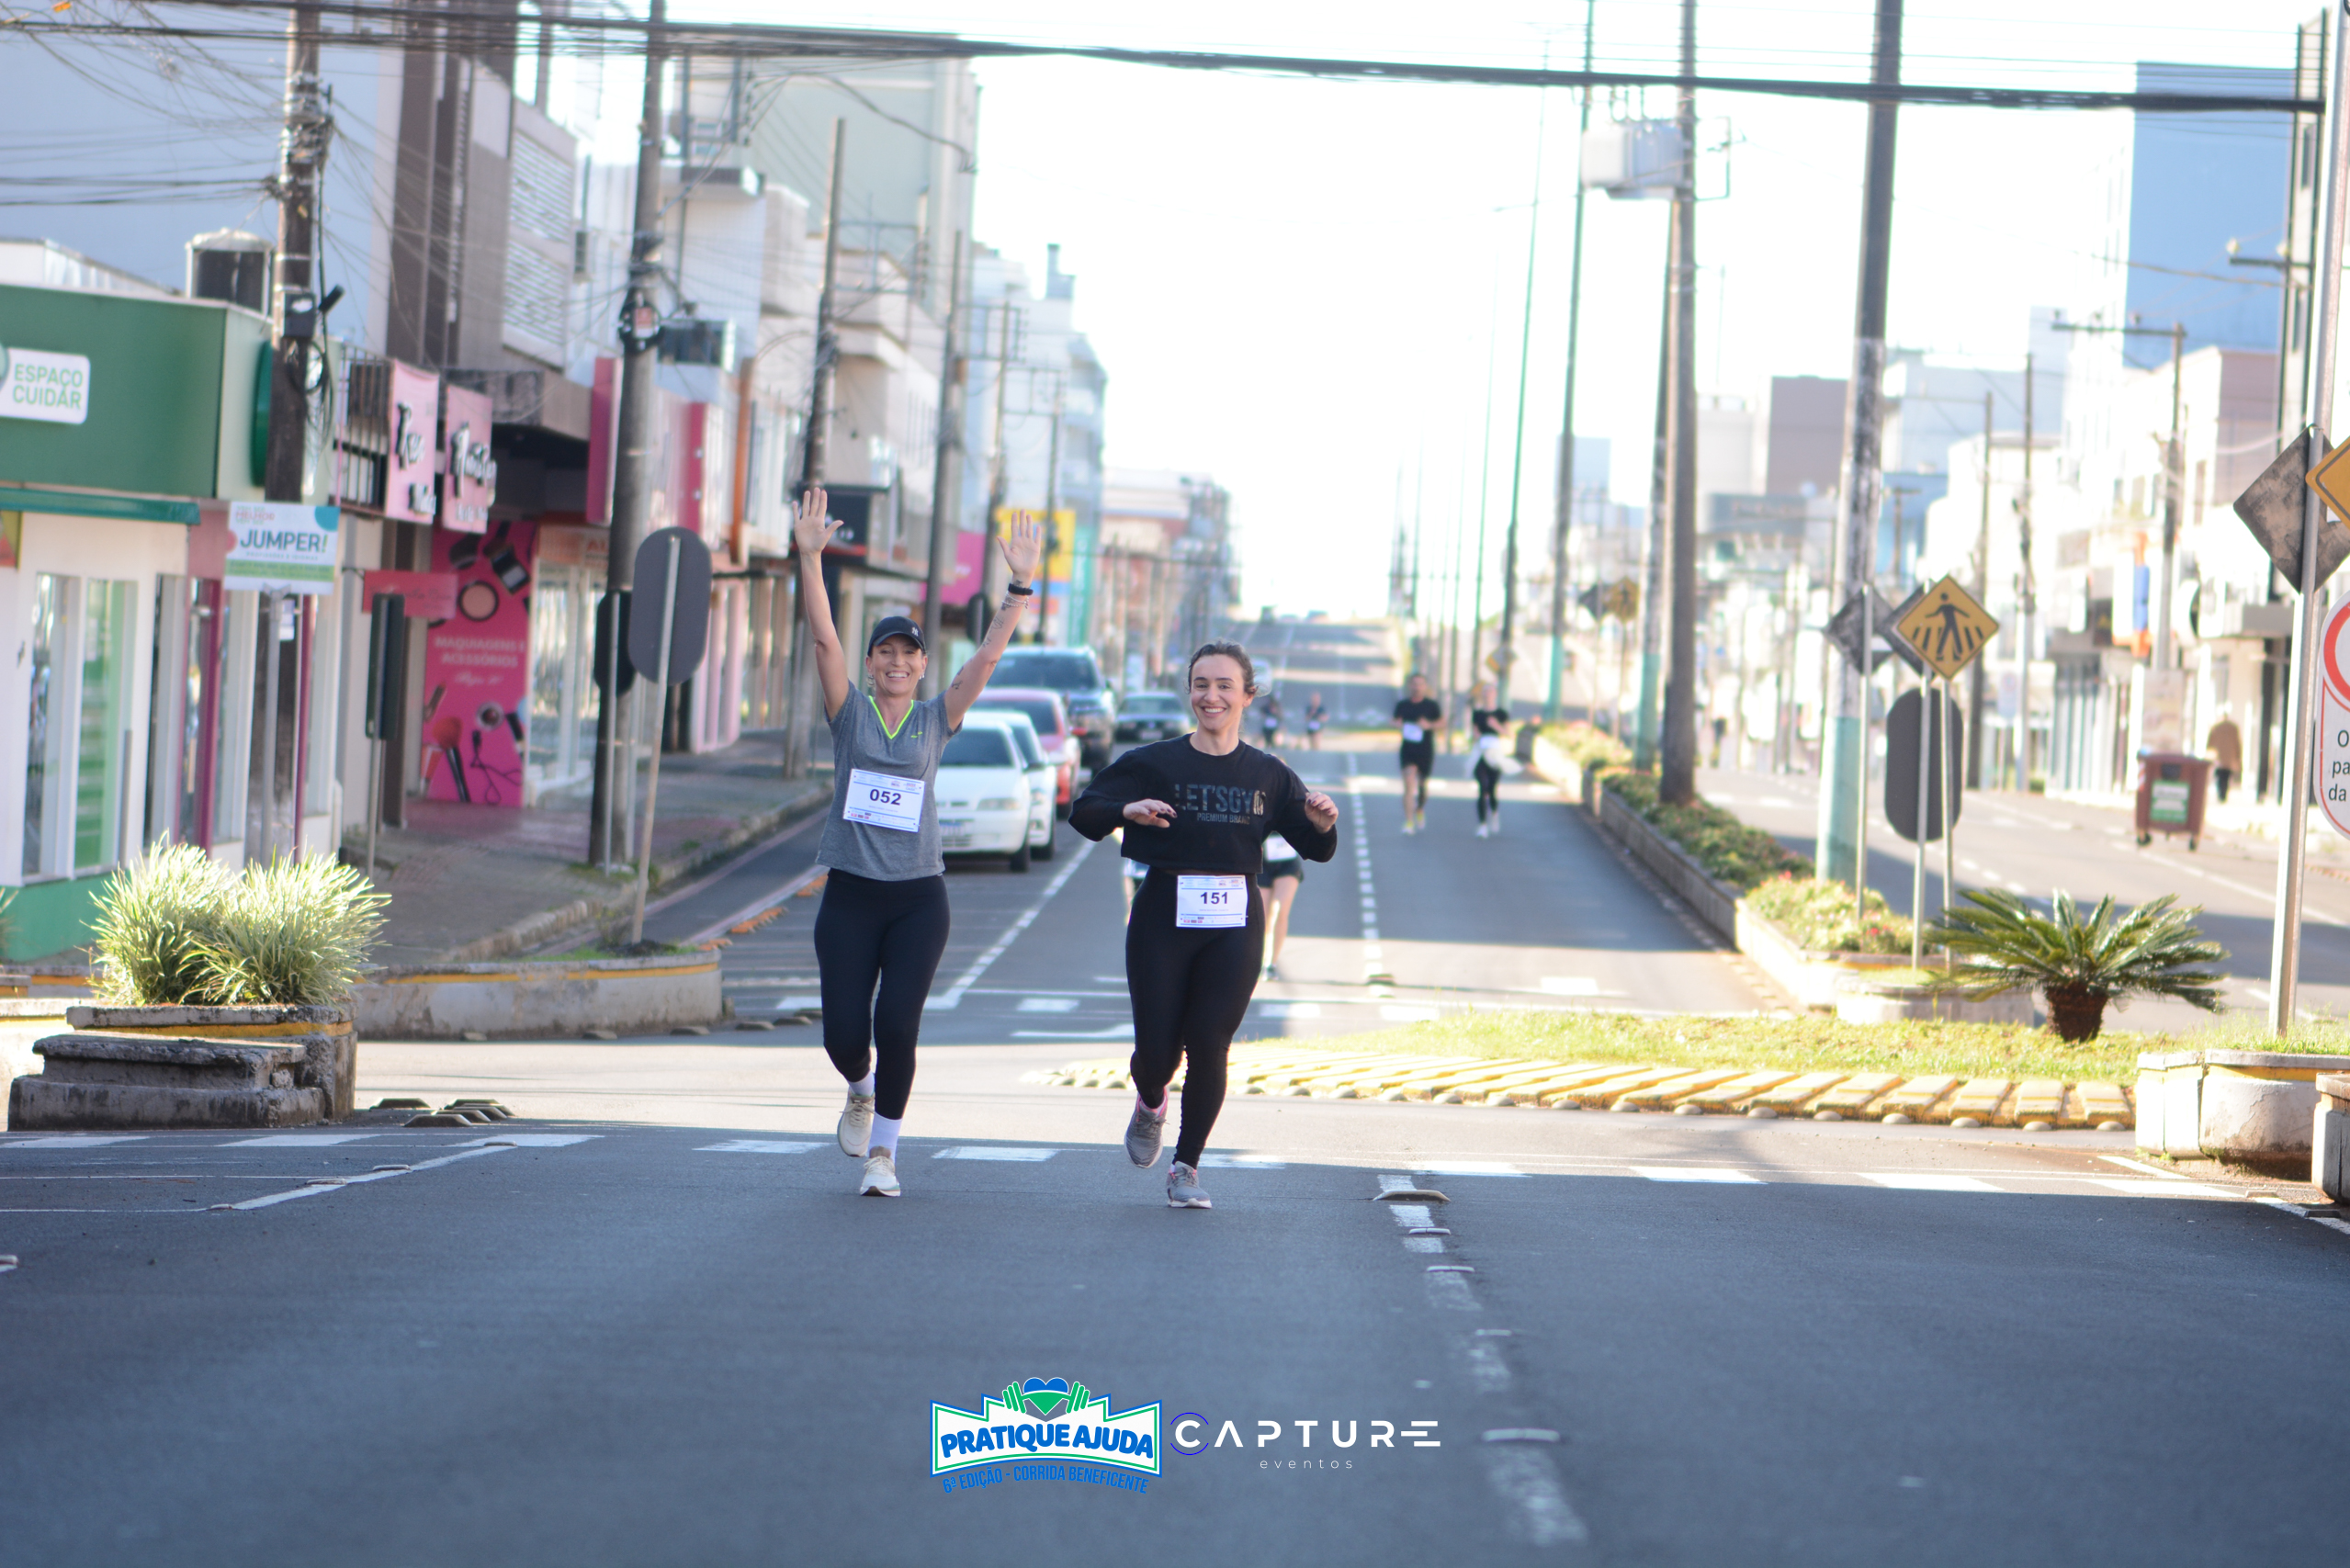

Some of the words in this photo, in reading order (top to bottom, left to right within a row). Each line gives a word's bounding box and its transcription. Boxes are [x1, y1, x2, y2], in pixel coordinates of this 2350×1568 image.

[15, 364, 83, 389] ESPAÇO
[13, 385, 82, 410] CUIDAR
[240, 529, 329, 553] JUMPER!
[435, 636, 517, 651] MAQUIAGENS
[869, 788, 902, 807] 052
[2328, 784, 2347, 802] da
[1197, 812, 1227, 823] PREMIUM
[1229, 815, 1250, 825] BRAND
[1200, 891, 1228, 905] 151
